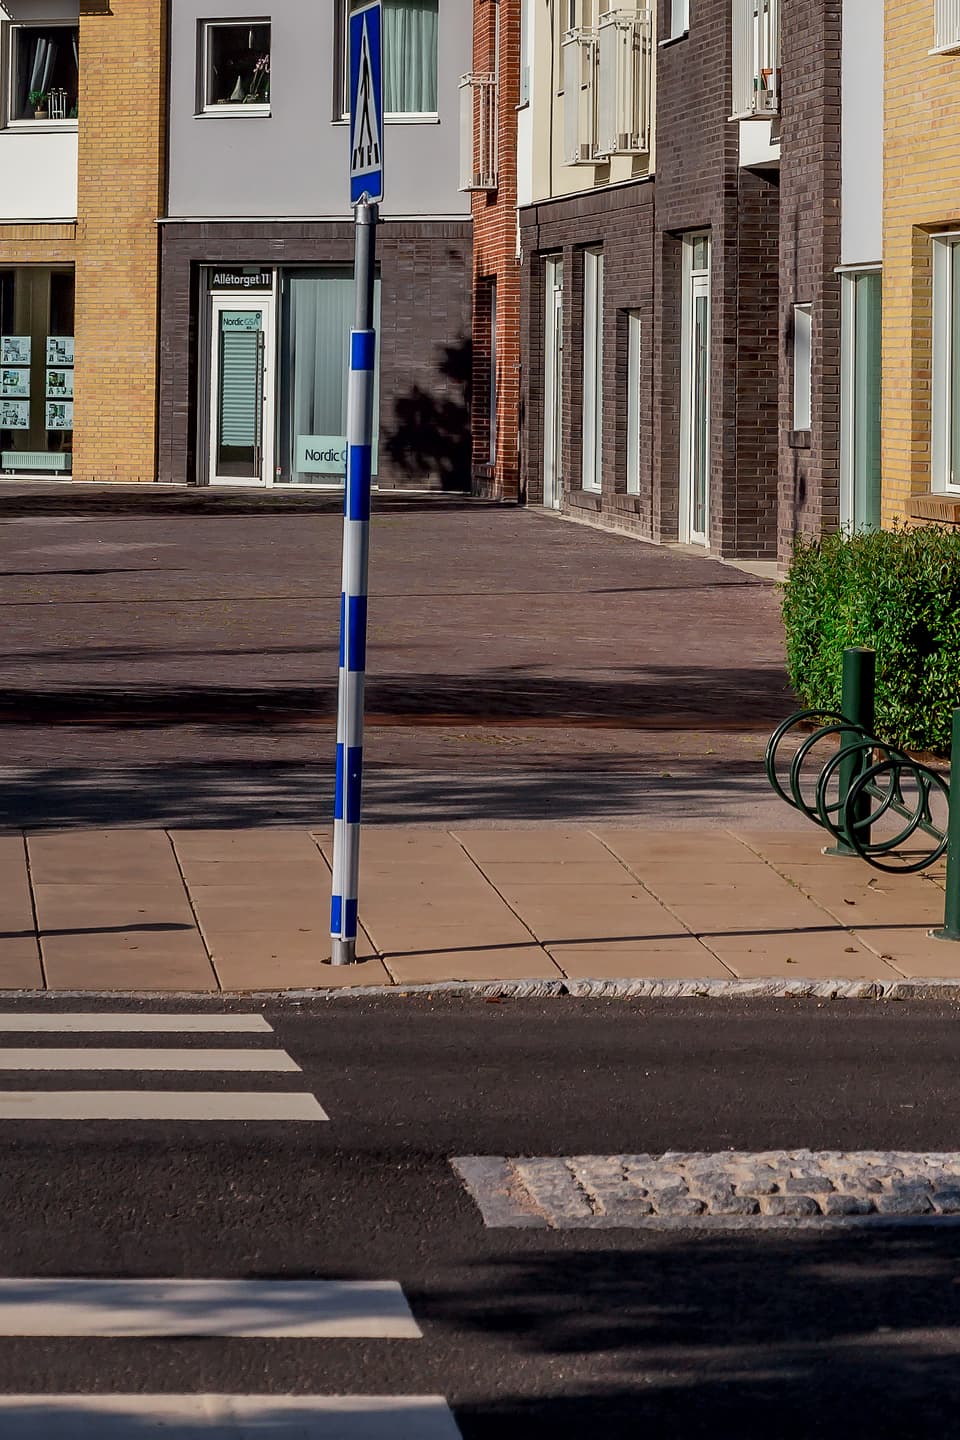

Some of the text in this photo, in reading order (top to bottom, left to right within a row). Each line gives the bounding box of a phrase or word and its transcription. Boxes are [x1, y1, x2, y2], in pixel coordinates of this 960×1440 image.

[213, 273, 269, 287] Allétorget 11
[223, 317, 244, 326] Nordic
[305, 448, 340, 462] Nordic
